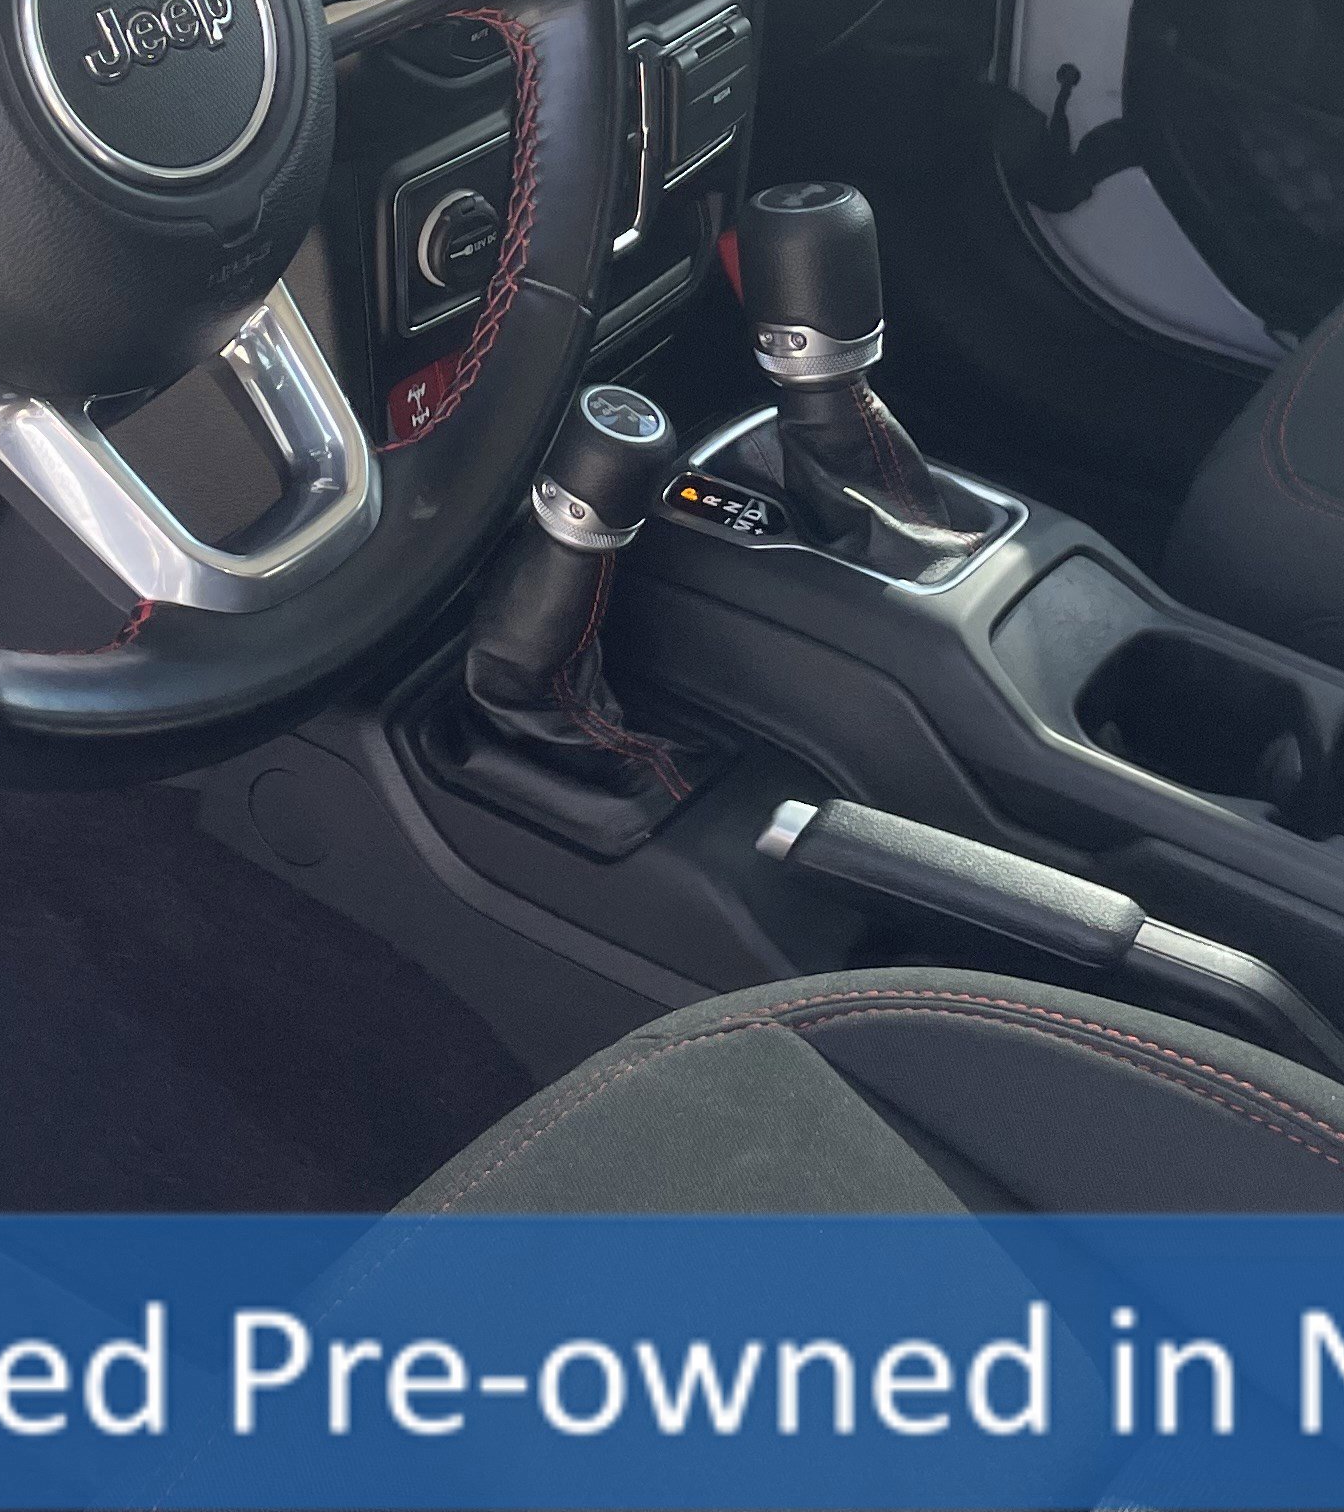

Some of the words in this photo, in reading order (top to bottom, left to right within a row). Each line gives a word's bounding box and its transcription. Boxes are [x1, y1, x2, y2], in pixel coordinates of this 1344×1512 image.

[702, 494, 722, 507] R
[722, 500, 744, 514] N
[745, 509, 763, 522] D
